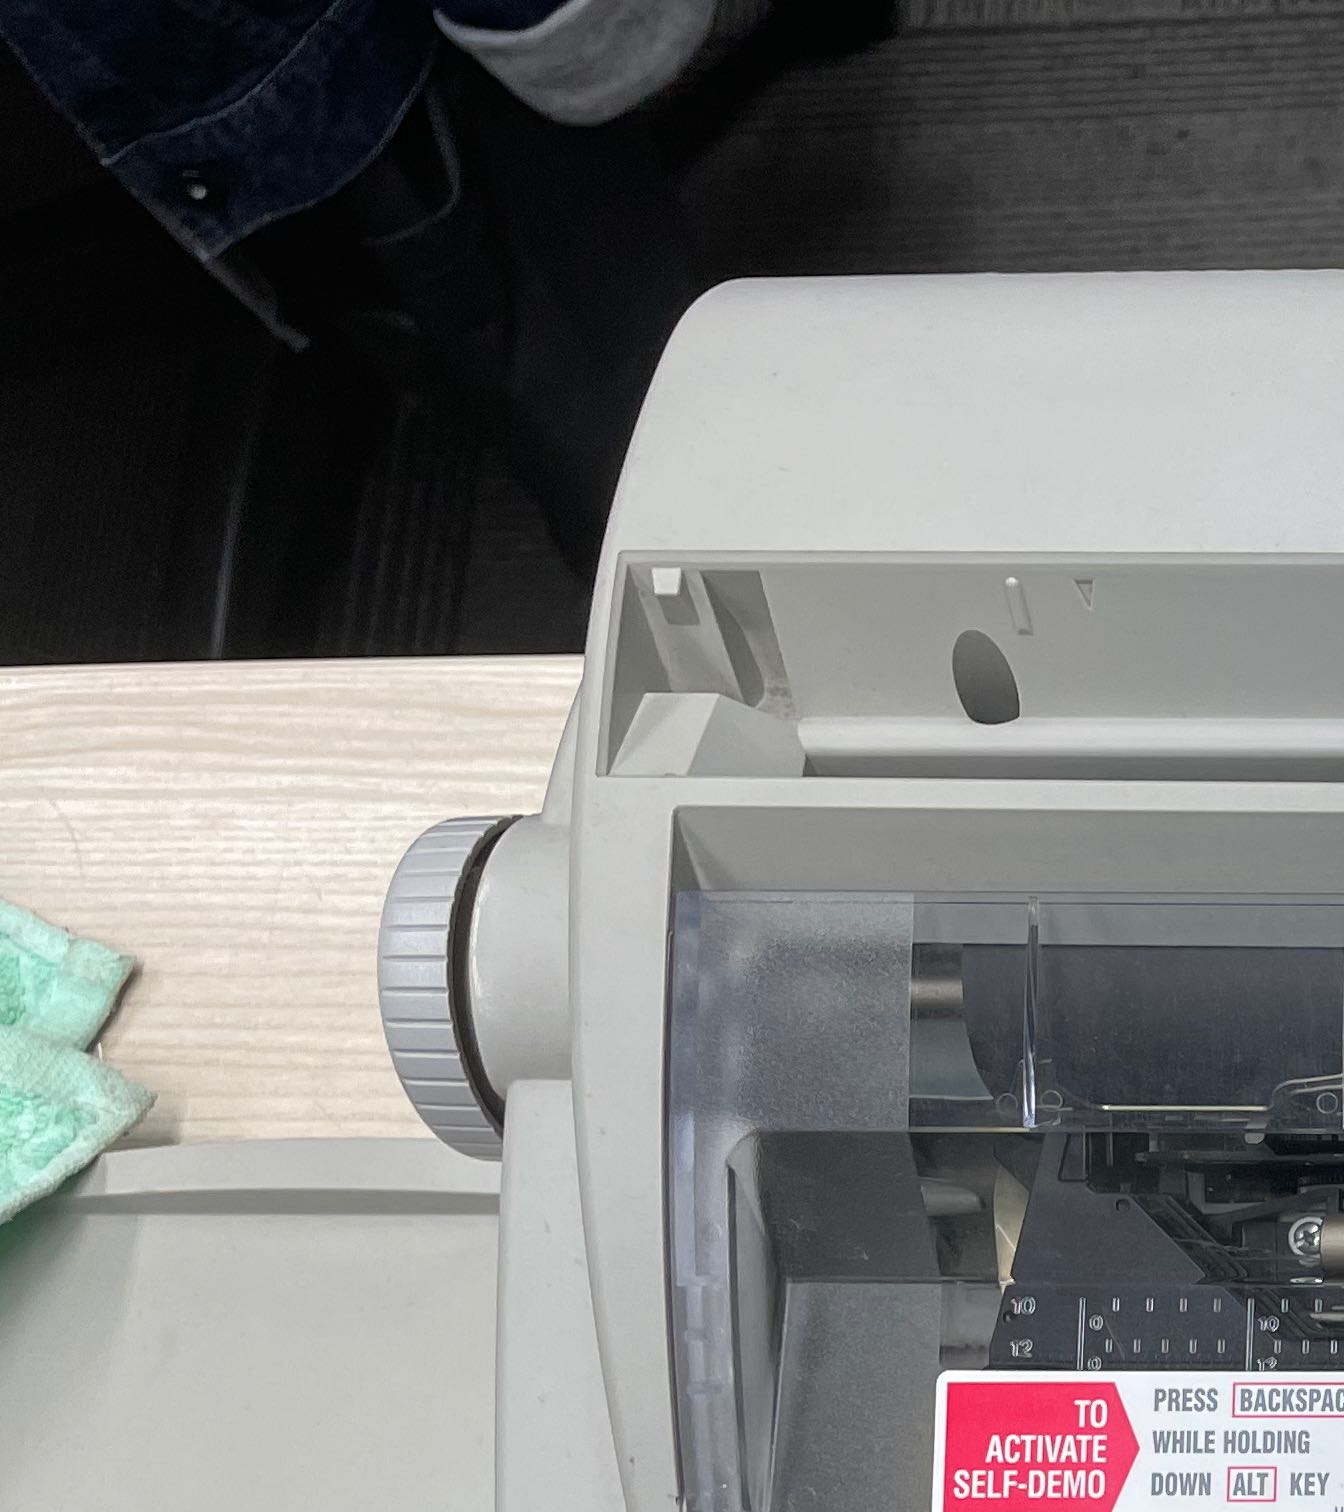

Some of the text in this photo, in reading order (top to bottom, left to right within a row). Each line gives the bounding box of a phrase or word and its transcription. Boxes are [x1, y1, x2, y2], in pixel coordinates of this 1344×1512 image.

[1010, 1296, 1036, 1315] 10
[1010, 1338, 1033, 1358] 12
[1153, 1388, 1219, 1412] PRESS
[1074, 1399, 1108, 1429] TO
[985, 1434, 1108, 1464] ACTIVATE
[1152, 1430, 1311, 1455] WHILE HOLDING
[953, 1469, 1106, 1500] SELF-DEMO
[1151, 1472, 1330, 1497] DOWN ALT KEY
